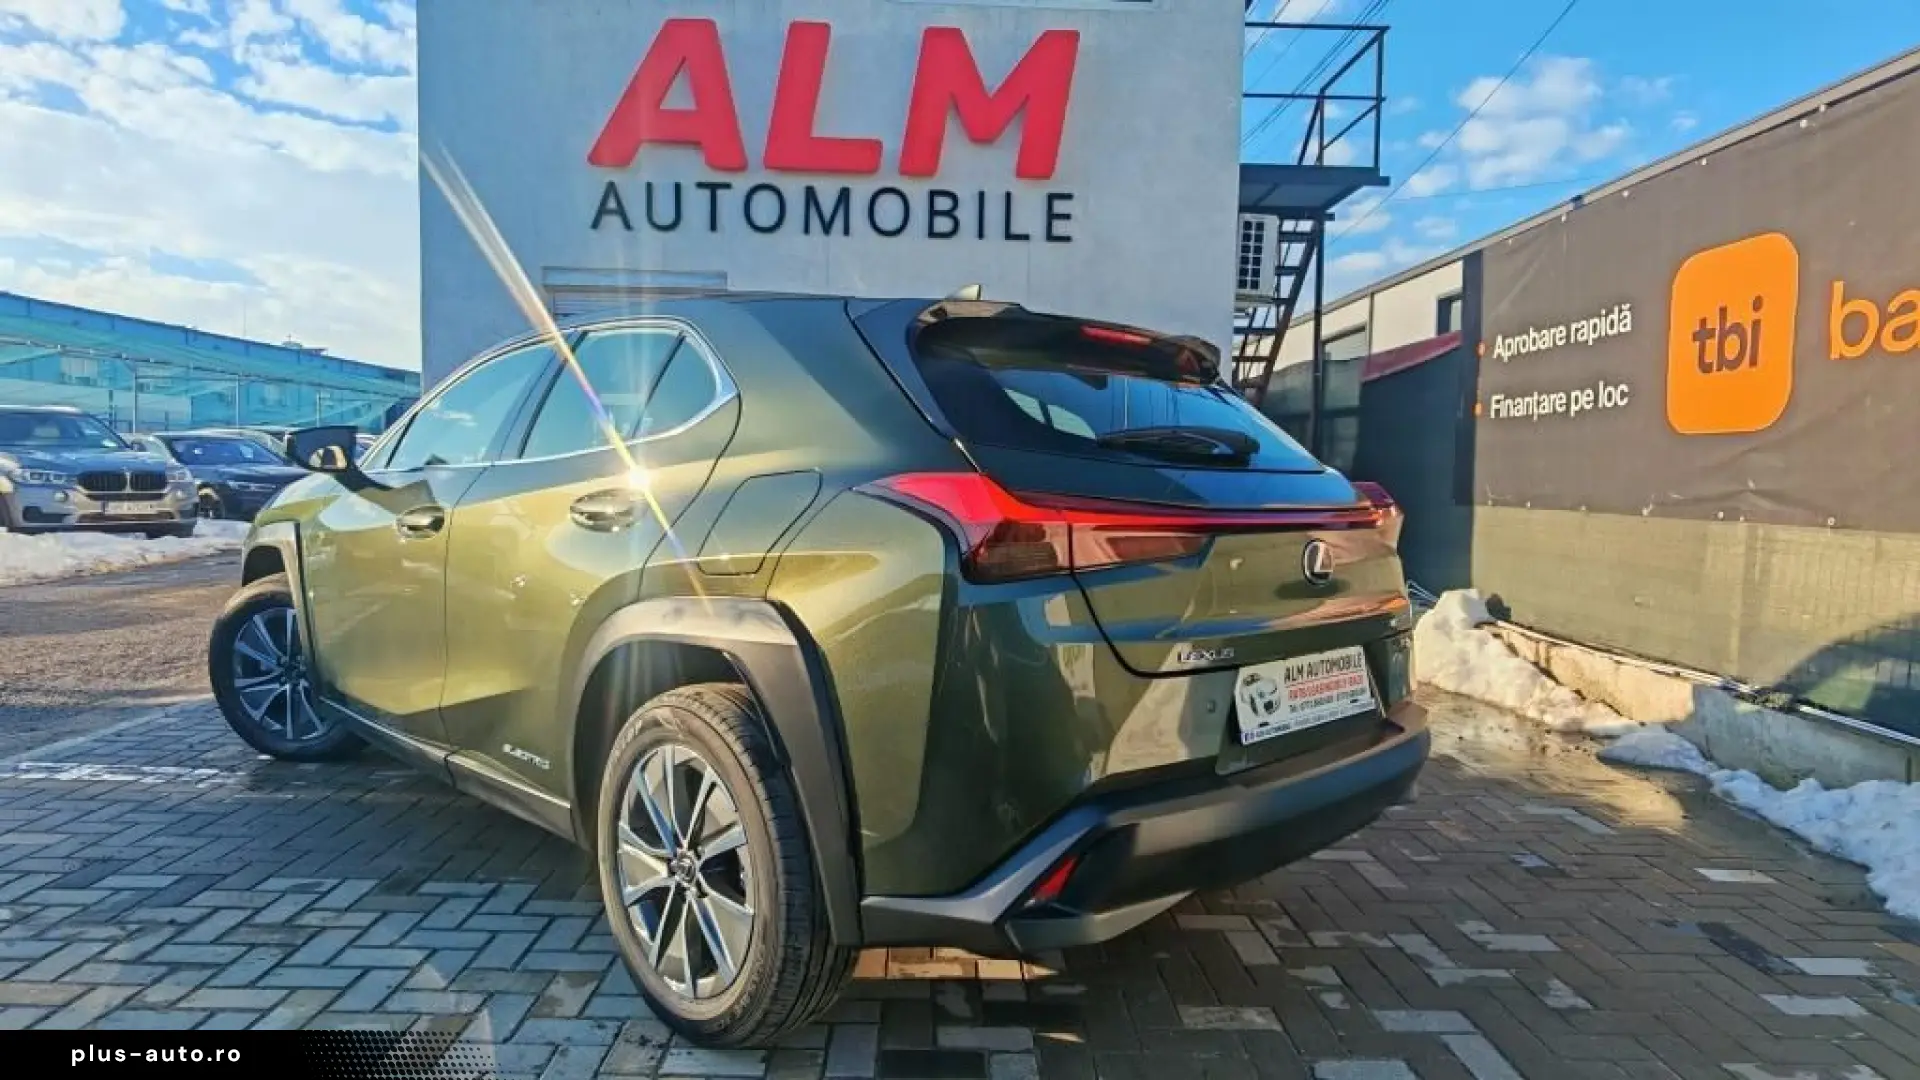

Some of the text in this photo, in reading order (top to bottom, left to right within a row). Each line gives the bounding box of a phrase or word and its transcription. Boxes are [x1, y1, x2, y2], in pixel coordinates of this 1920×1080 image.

[587, 18, 1081, 180] ALM
[590, 180, 1075, 243] AUTOMOBILE
[1493, 303, 1633, 359] Aprobare rapidă
[1691, 295, 1764, 374] tbi
[1570, 388, 1595, 417] pe
[1599, 381, 1630, 408] loc
[1284, 652, 1362, 683] ALM AUTOMOBILE
